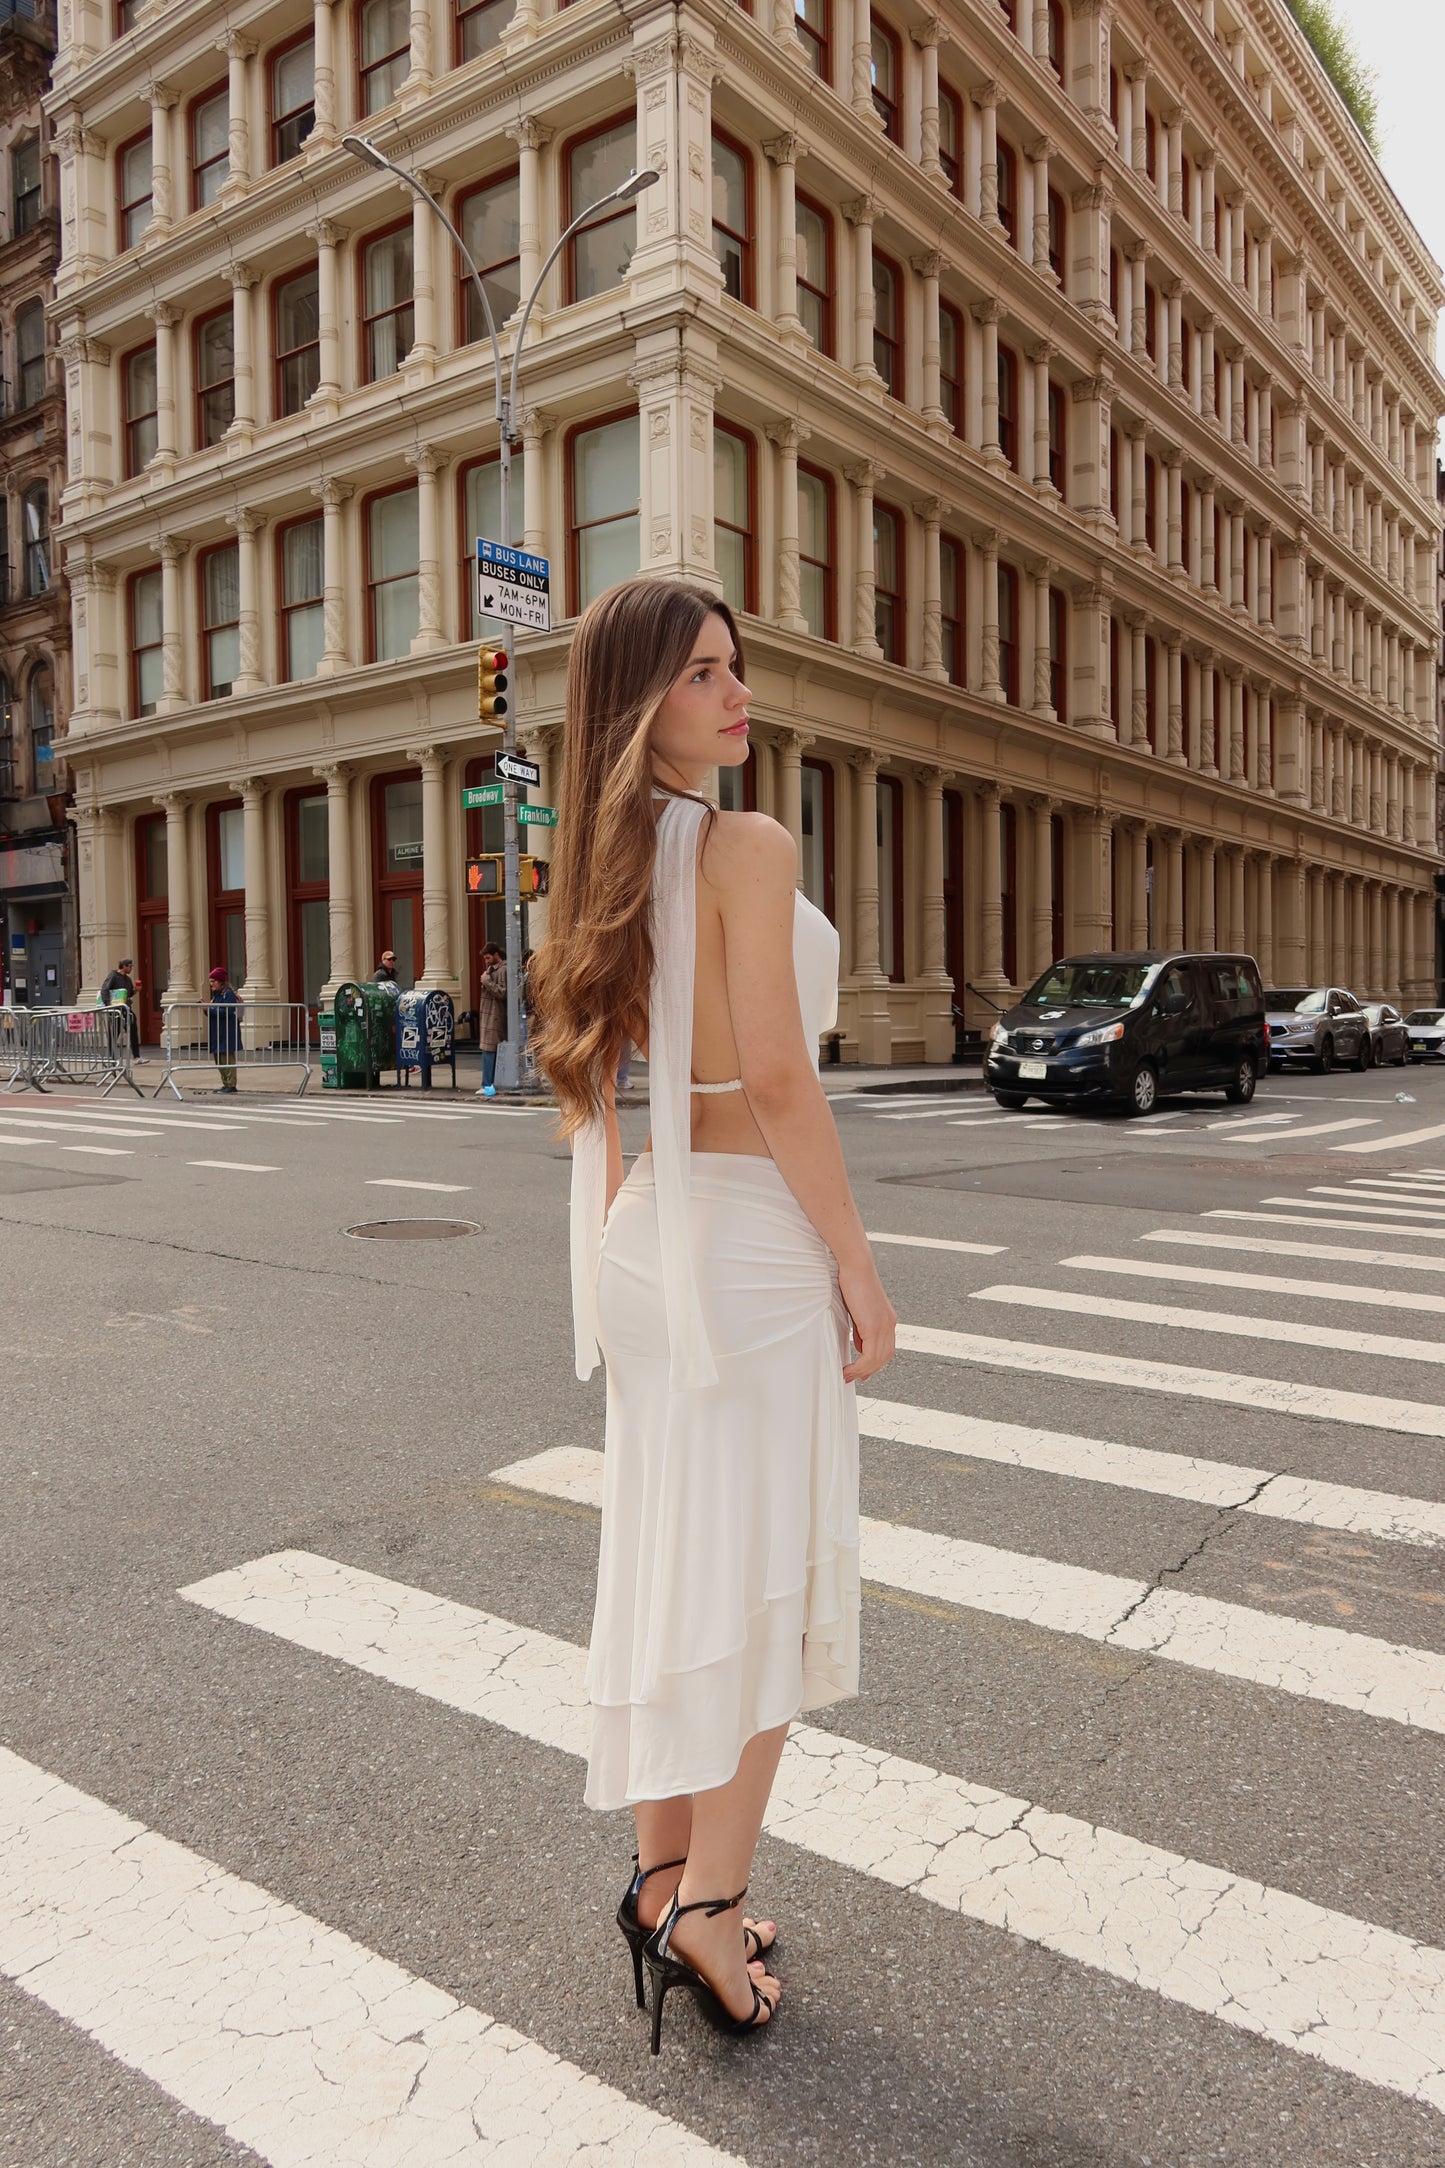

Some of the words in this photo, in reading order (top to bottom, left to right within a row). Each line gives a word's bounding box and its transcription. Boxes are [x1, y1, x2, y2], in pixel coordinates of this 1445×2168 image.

[496, 548, 516, 564] BUS
[519, 555, 546, 574] LANE
[482, 562, 516, 582] BUSES
[519, 572, 545, 590] ONLY
[503, 762, 518, 774] ONE
[520, 767, 535, 778] WAY
[468, 789, 499, 805] Broadway
[520, 806, 550, 824] Franklin
[397, 846, 419, 855] ALMINE
